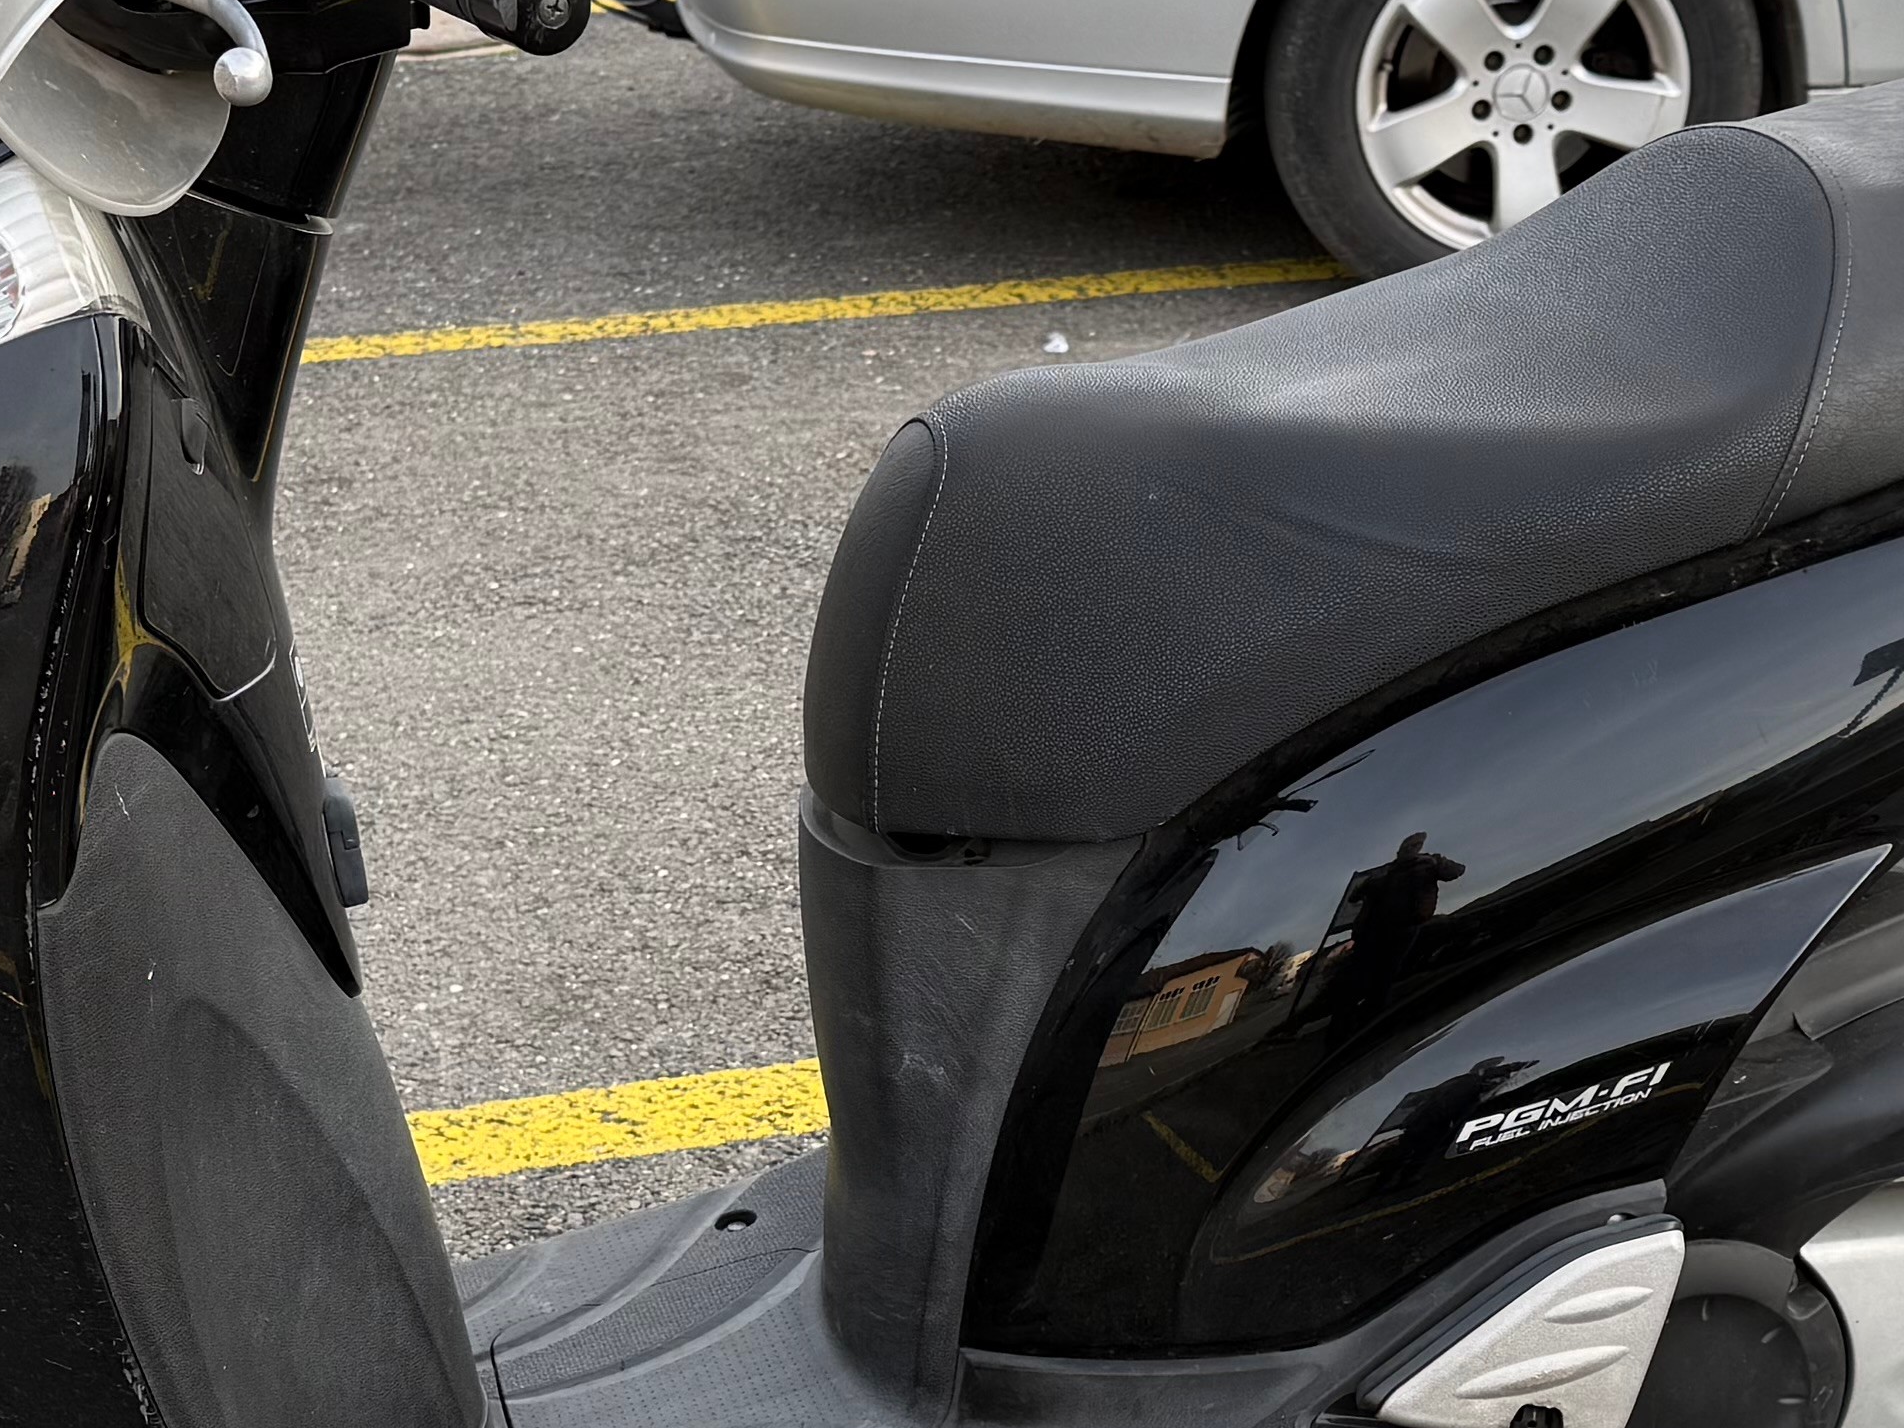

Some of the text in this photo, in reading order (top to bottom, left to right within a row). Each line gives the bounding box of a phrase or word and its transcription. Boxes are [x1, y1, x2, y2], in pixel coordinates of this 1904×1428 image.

[1455, 1061, 1673, 1143] PGM-FI
[1469, 1088, 1652, 1151] FUEL INJECTION
